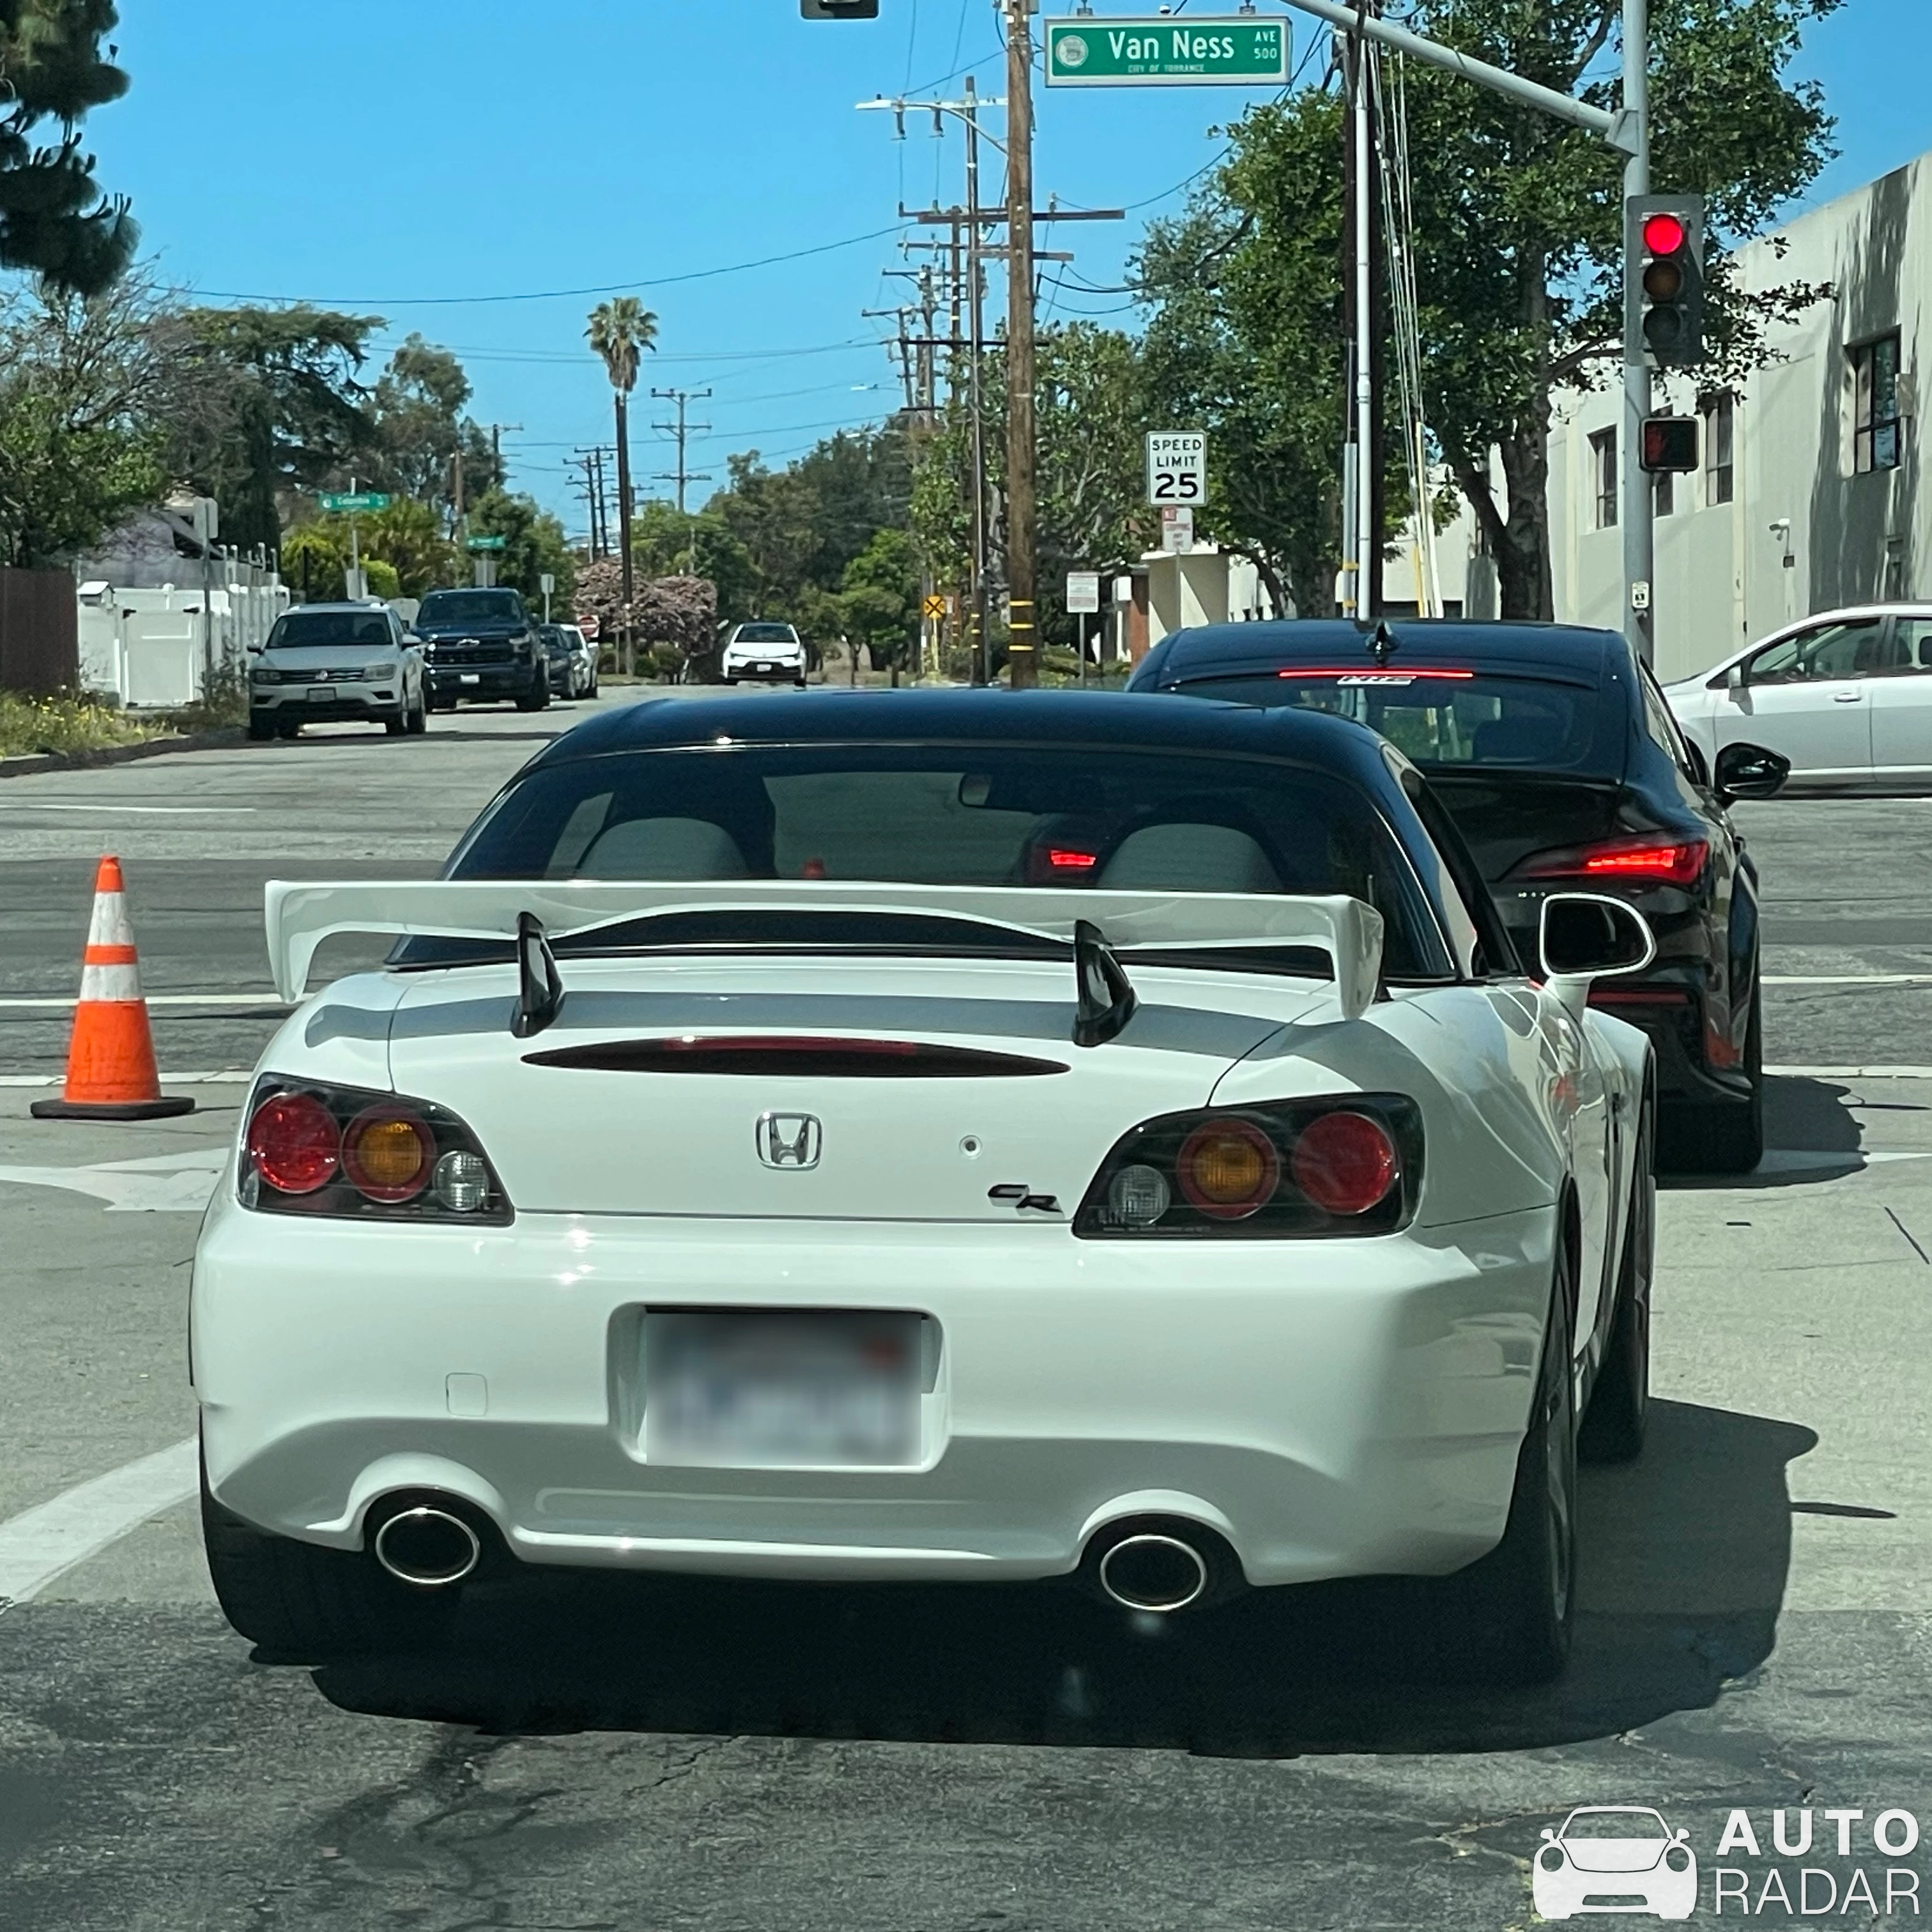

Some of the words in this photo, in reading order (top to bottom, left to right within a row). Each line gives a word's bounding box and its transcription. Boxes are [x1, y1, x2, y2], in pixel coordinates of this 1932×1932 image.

[1255, 31, 1276, 43] AVE
[1108, 31, 1159, 59] Van
[1172, 30, 1234, 59] Ness
[1254, 48, 1277, 59] 500
[1128, 65, 1144, 73] CITY
[1152, 439, 1202, 451] SPEED
[1156, 456, 1197, 467] LIMIT
[1155, 473, 1198, 498] 25
[988, 1184, 1064, 1217] CR
